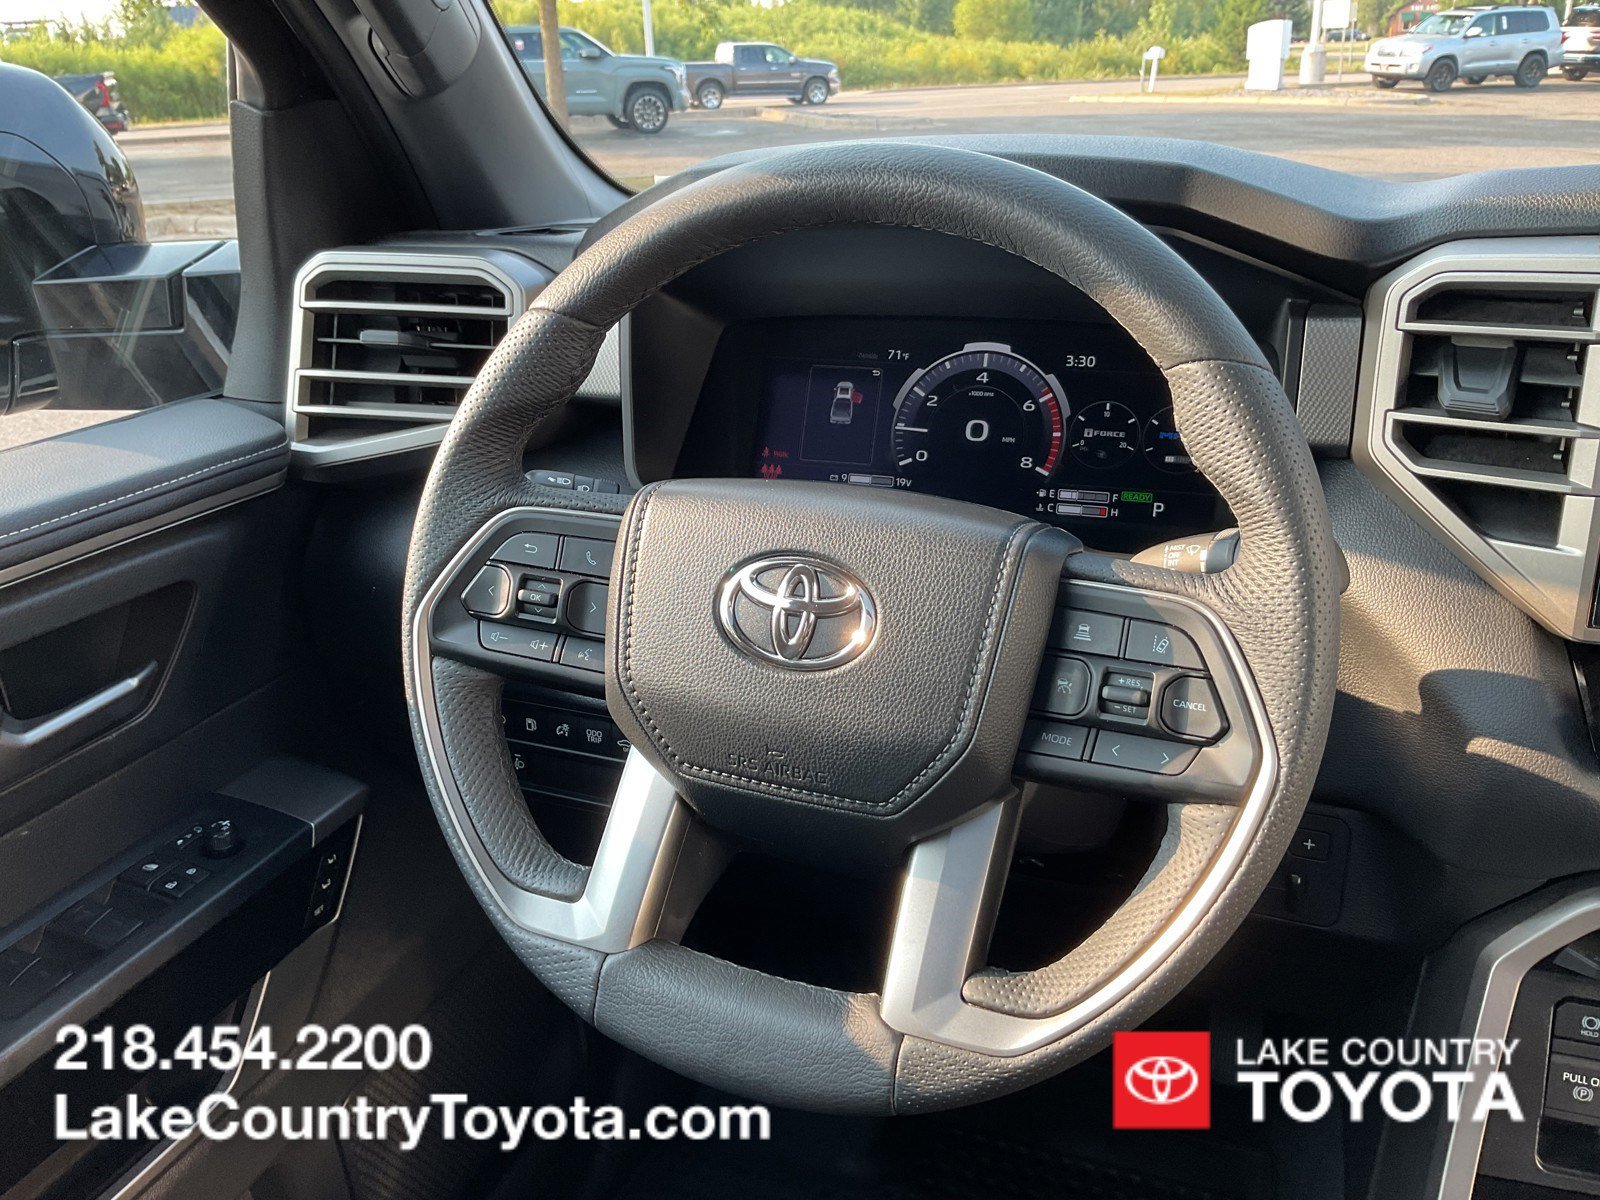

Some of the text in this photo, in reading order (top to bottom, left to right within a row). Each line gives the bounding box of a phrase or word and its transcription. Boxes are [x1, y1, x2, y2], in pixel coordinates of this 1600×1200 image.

[1065, 355, 1097, 367] 3:30
[975, 371, 990, 384] 4
[926, 395, 938, 407] 2
[1022, 400, 1036, 412] 6
[965, 419, 989, 442] 0
[915, 450, 928, 461] 0
[1020, 457, 1033, 469] 8
[841, 473, 848, 482] 9
[1048, 489, 1055, 498] E
[1112, 493, 1119, 502] F
[1122, 492, 1151, 501] READY
[1047, 503, 1054, 512] C
[1110, 507, 1119, 517] H
[1152, 502, 1165, 518] P
[1169, 544, 1186, 552] MIST
[1167, 559, 1179, 567] INT
[529, 593, 542, 602] OK
[1172, 699, 1207, 712] CANCEL
[585, 728, 603, 738] ODO
[587, 735, 602, 744] TRIP
[1041, 732, 1073, 746] MODE
[764, 760, 830, 787] AIRBAG
[1580, 1029, 1600, 1038] HOLD
[1562, 1071, 1588, 1085] PULL
